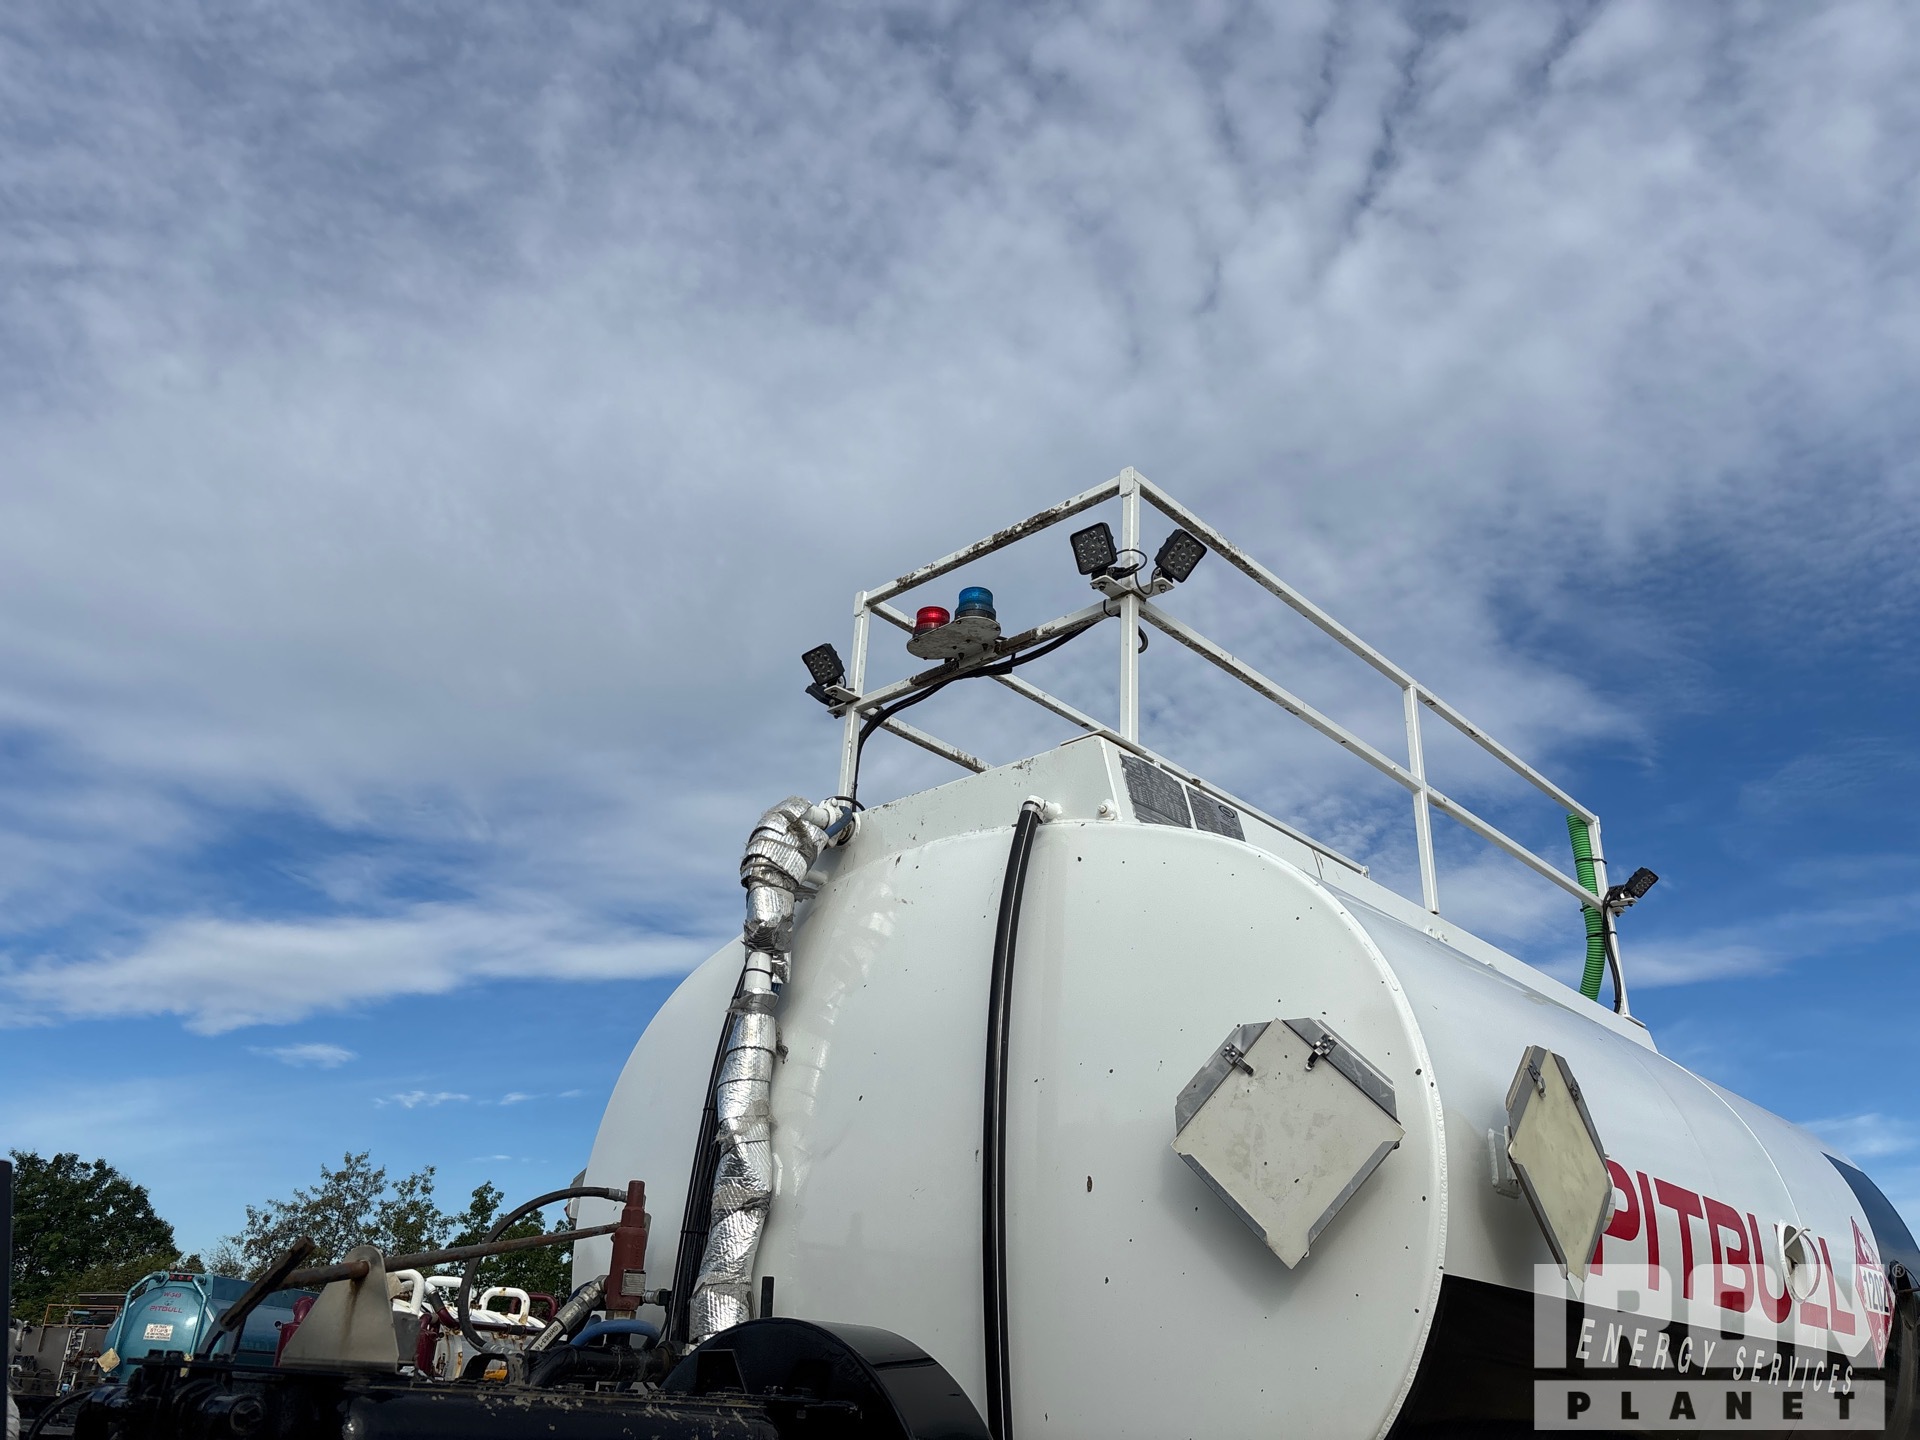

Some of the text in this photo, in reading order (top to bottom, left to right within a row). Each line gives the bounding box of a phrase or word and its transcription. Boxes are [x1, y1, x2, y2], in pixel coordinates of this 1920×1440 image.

[150, 1305, 183, 1313] PITBULL
[1863, 1269, 1889, 1313] 1202
[1575, 1317, 1854, 1396] ENERGY SERVICES
